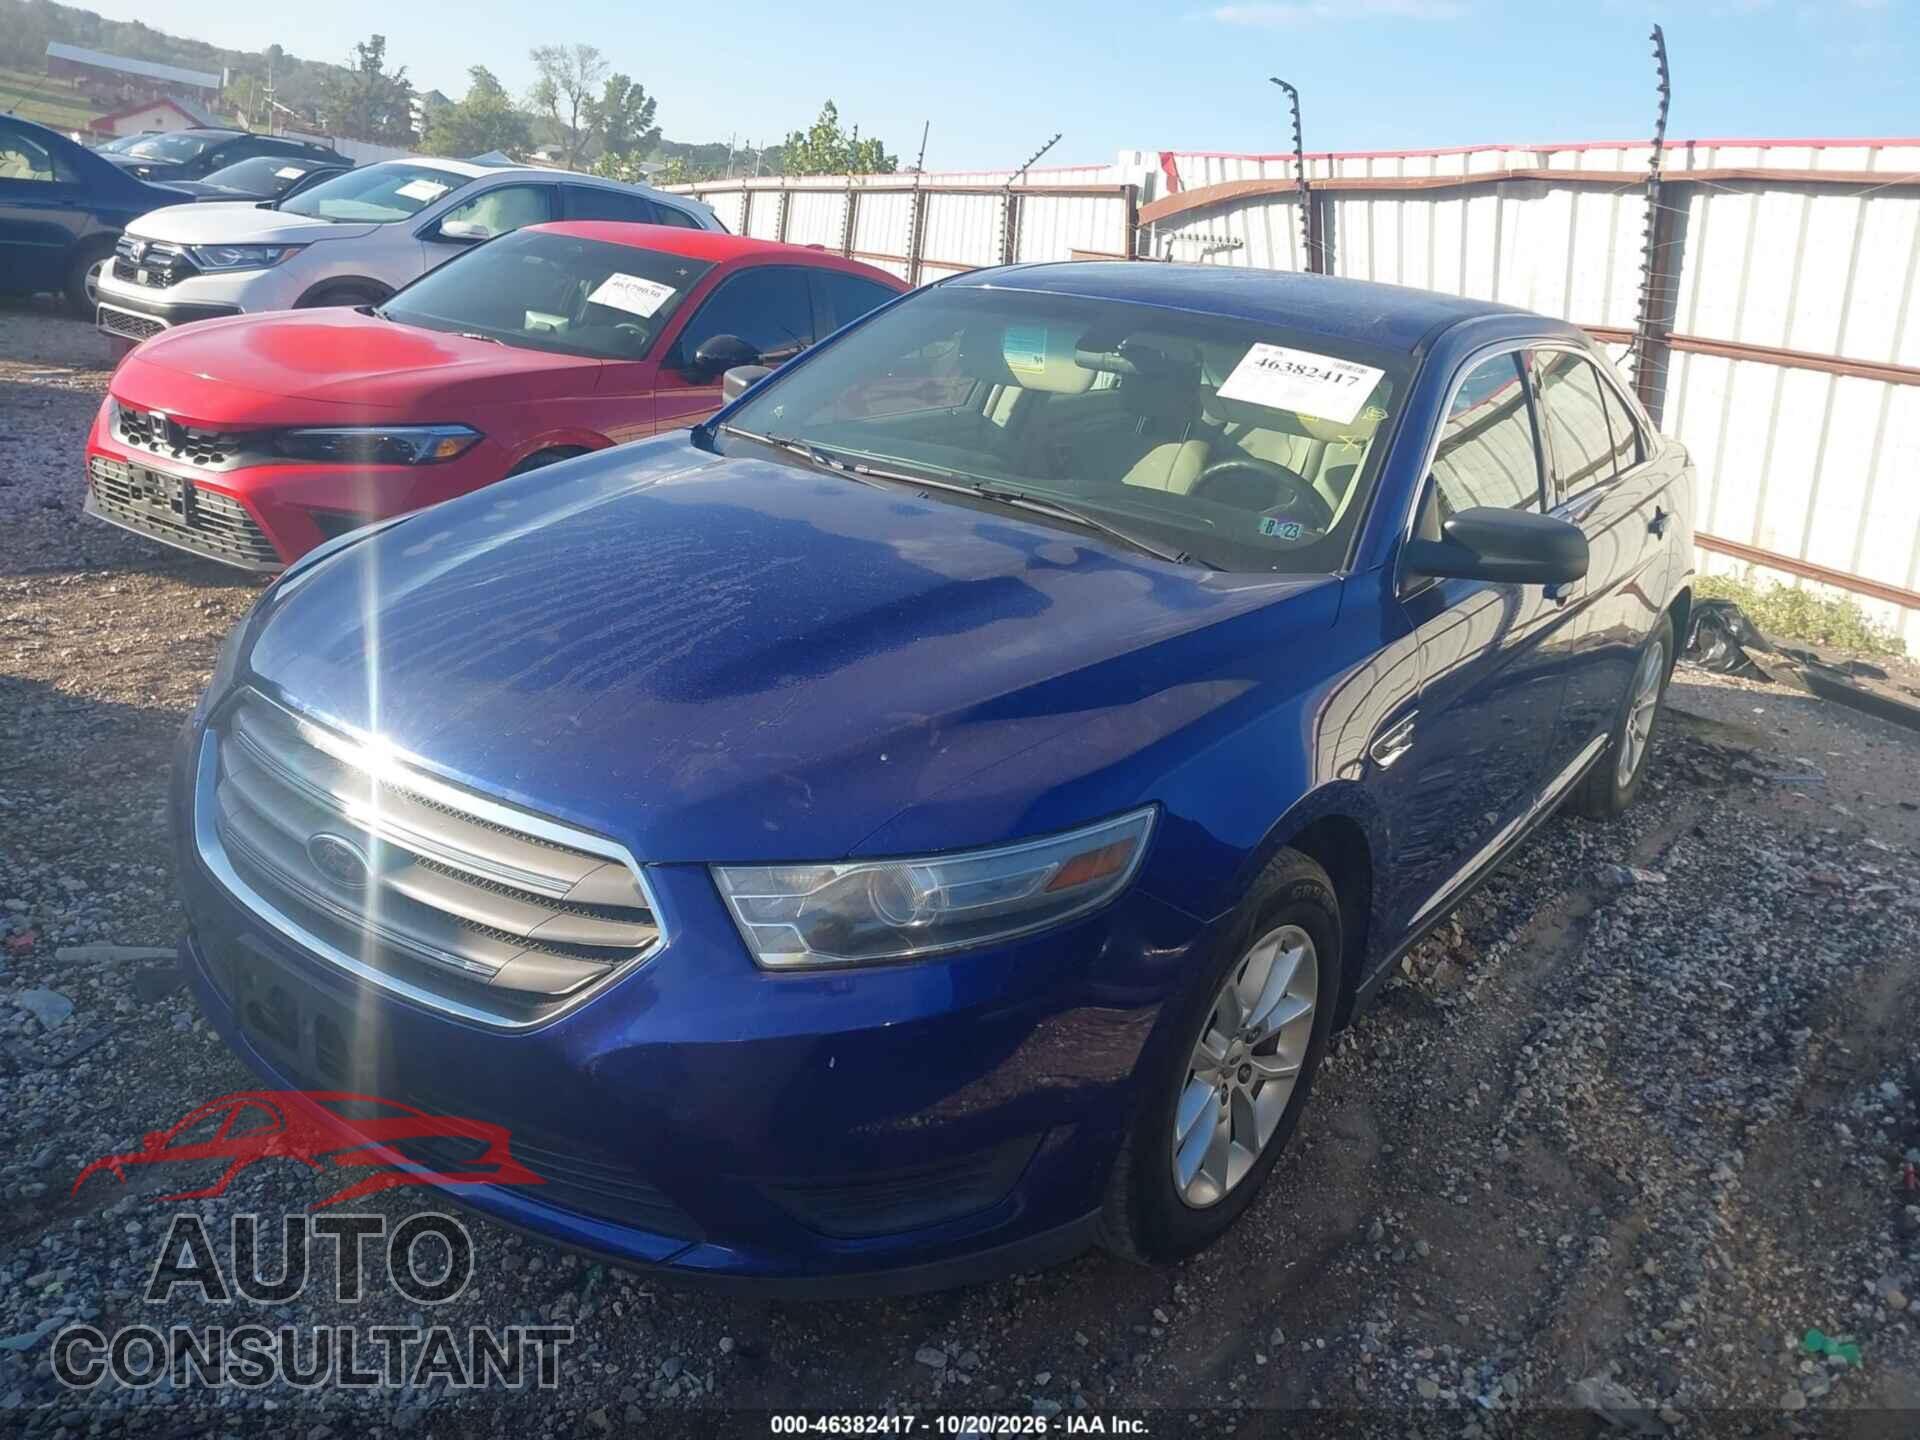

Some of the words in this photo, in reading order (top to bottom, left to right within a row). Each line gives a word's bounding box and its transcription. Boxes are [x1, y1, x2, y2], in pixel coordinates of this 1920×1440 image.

[1254, 357, 1361, 386] 46382417
[1265, 519, 1276, 534] 8
[1283, 523, 1299, 538] 23
